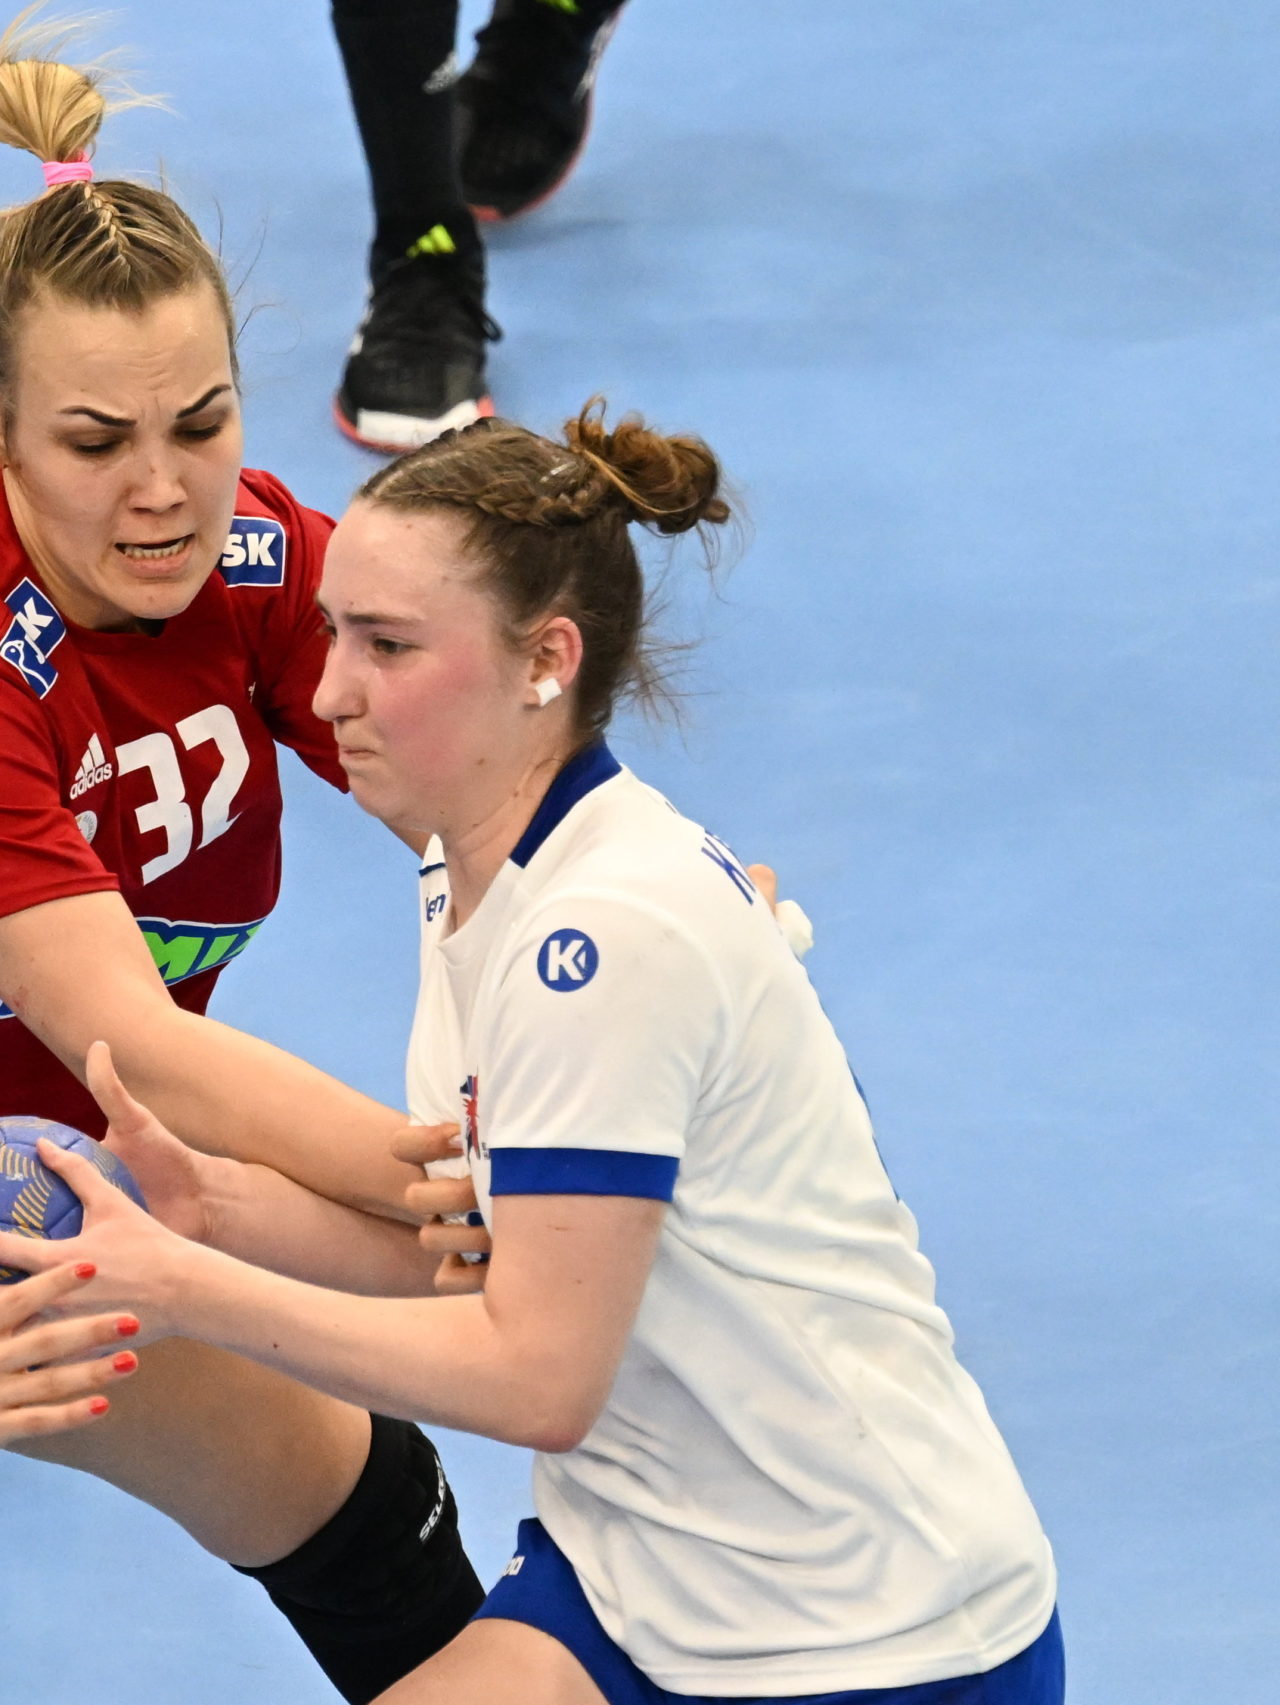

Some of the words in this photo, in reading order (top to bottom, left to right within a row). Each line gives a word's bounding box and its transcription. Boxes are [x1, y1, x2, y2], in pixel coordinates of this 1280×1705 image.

[222, 533, 276, 567] SK
[69, 763, 113, 800] adidas
[115, 704, 250, 886] 32
